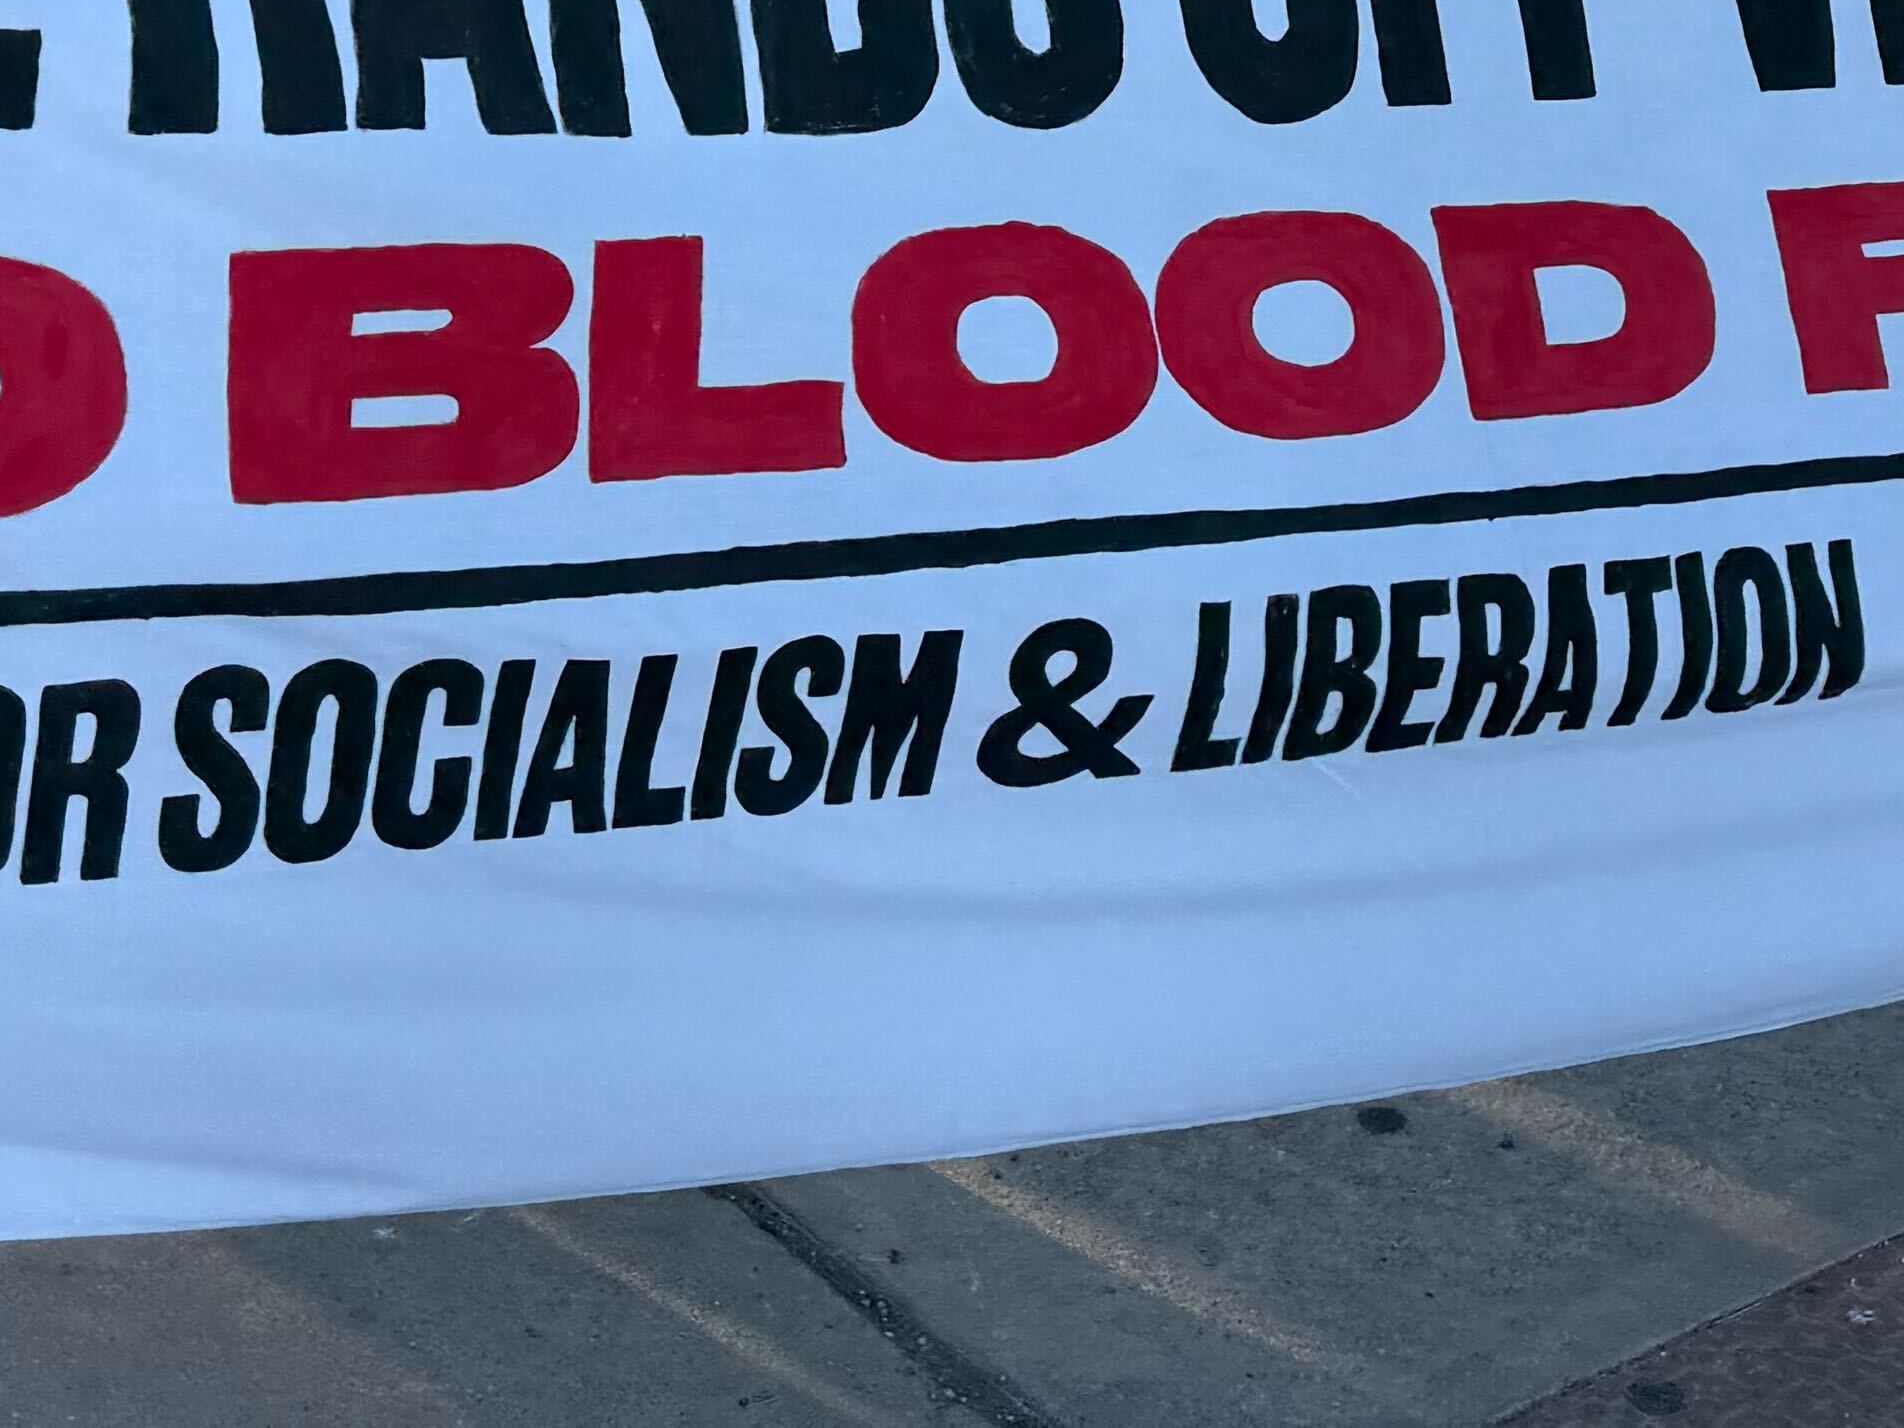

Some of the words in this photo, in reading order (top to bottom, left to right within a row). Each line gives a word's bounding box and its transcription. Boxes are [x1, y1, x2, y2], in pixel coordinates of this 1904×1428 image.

[227, 199, 1717, 506] BLOOD
[158, 628, 967, 874] SOCIALISM
[975, 616, 1155, 789] &
[1168, 538, 1867, 775] LIBERATION
